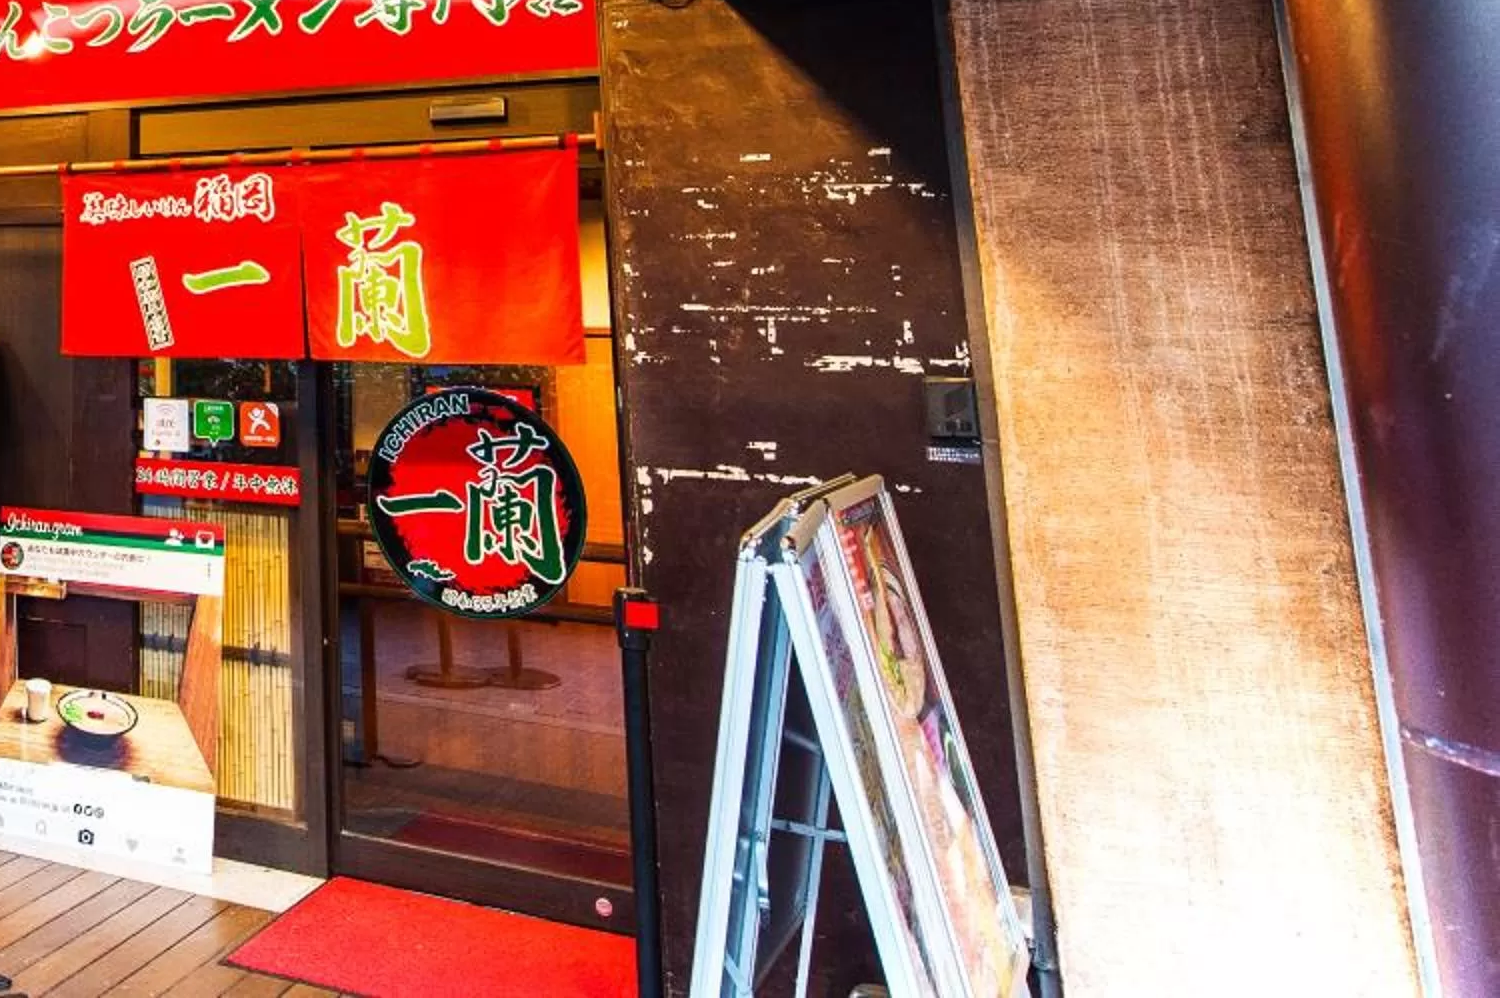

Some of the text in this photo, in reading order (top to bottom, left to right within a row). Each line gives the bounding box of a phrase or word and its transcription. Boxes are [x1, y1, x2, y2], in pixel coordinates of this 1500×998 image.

[182, 202, 432, 358] 一蘭
[377, 422, 567, 585] 一蘭
[378, 393, 470, 463] ICHIRAN
